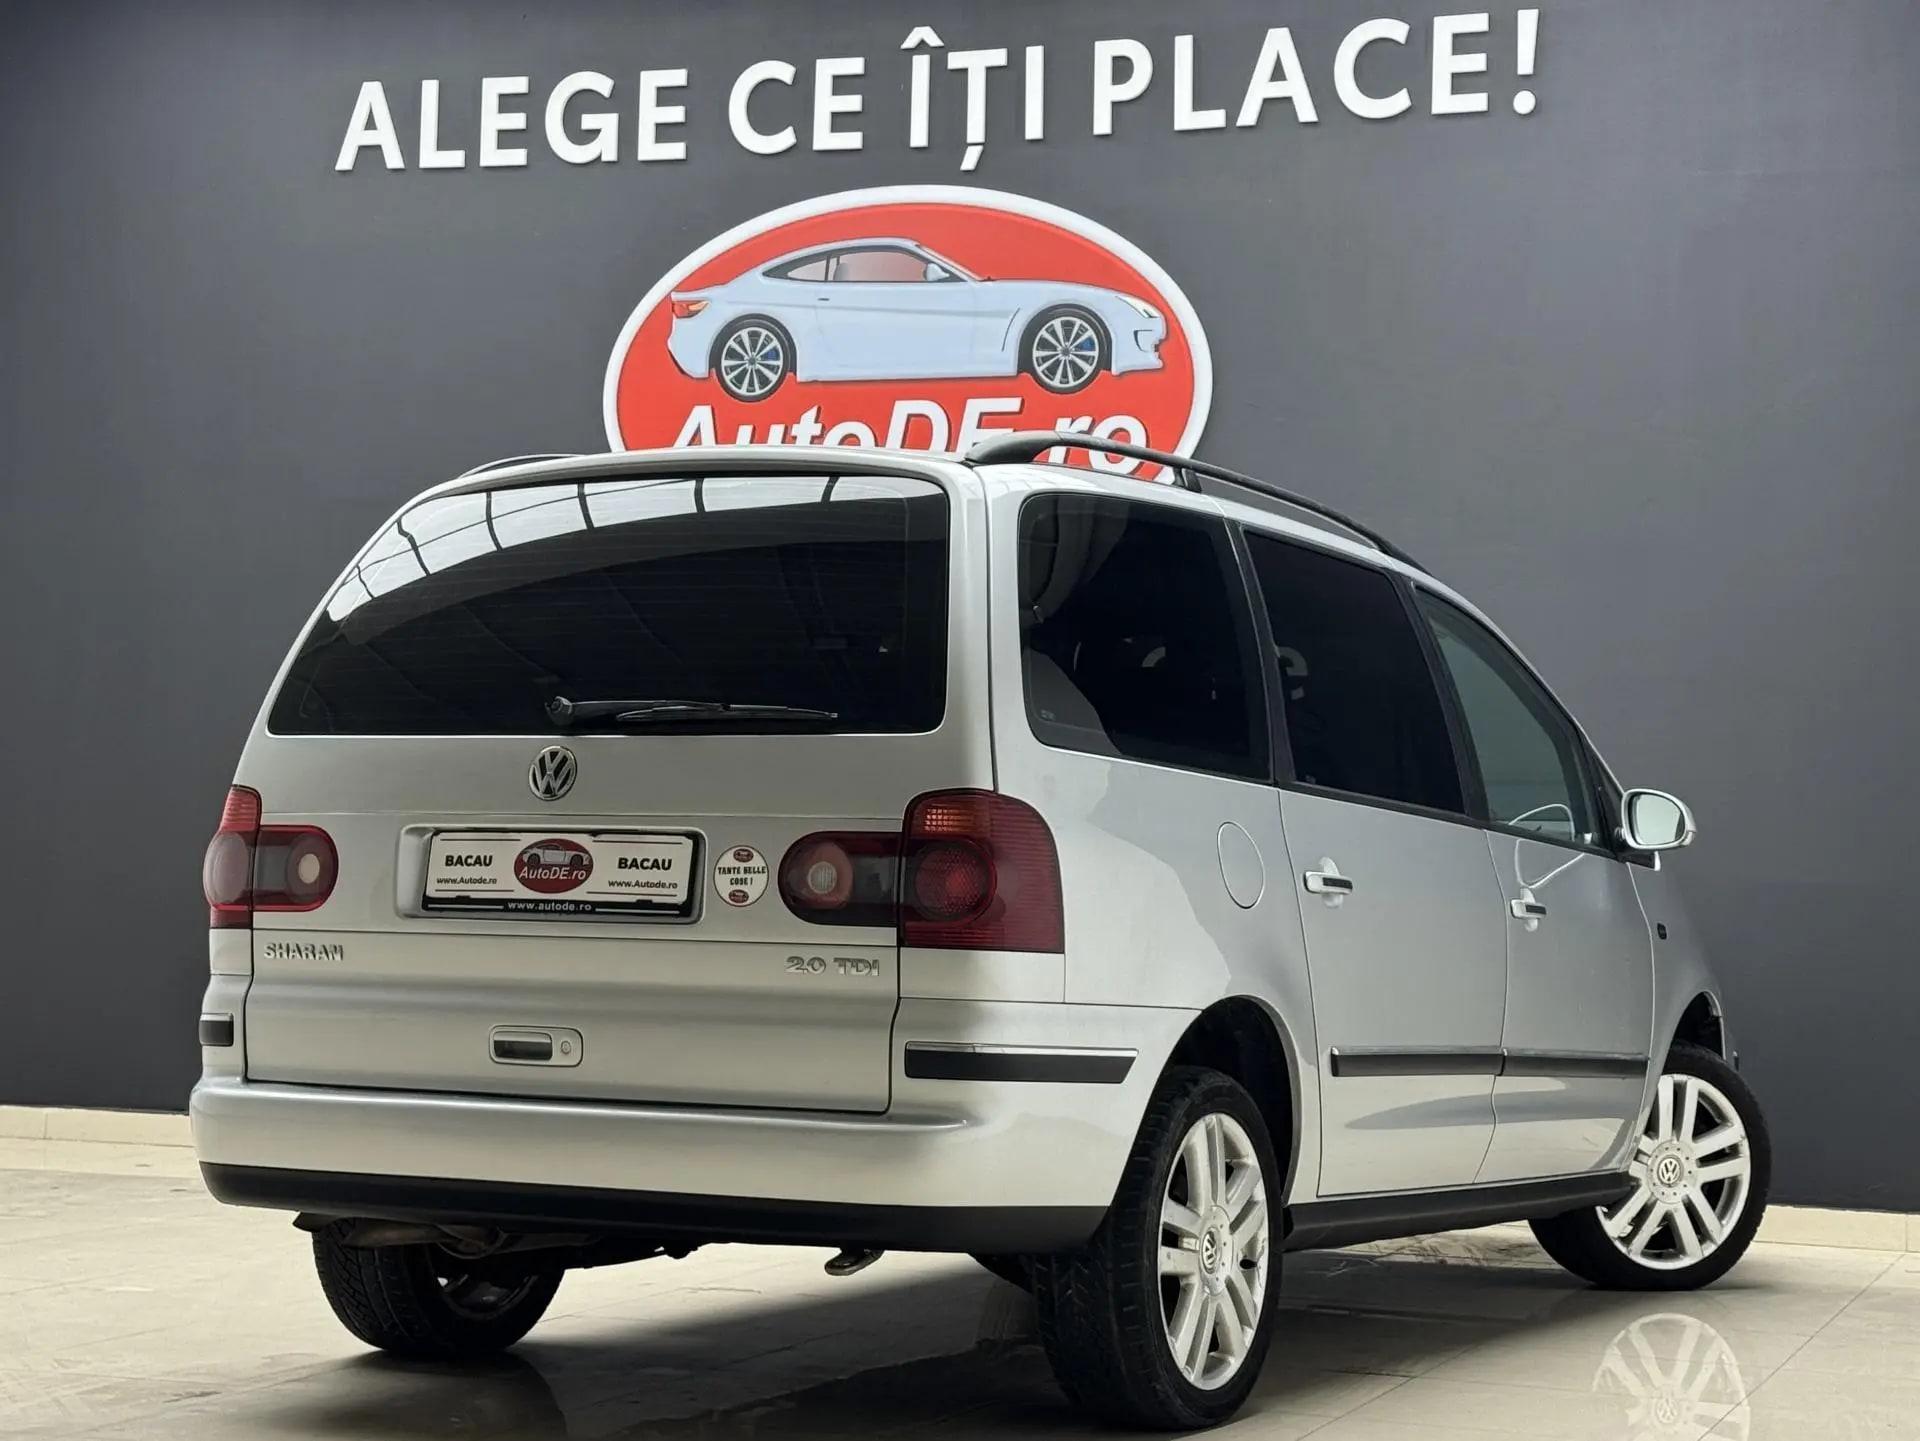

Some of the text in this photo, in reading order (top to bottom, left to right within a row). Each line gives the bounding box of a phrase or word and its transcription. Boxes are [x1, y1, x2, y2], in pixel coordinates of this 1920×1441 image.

[335, 68, 689, 171] ALEGE
[728, 57, 865, 155] CE
[1092, 8, 1540, 136] PLACE!
[445, 855, 493, 867] BACAU
[617, 857, 672, 871] BACAU
[519, 867, 586, 881] AutoDE.ro
[718, 866, 741, 875] TANTE
[437, 877, 497, 885] www.Autode.ro
[608, 880, 678, 889] www.Autode.ro
[508, 901, 592, 912] www.autode.ro
[264, 942, 344, 961] SHARAN
[832, 957, 880, 976] TDI
